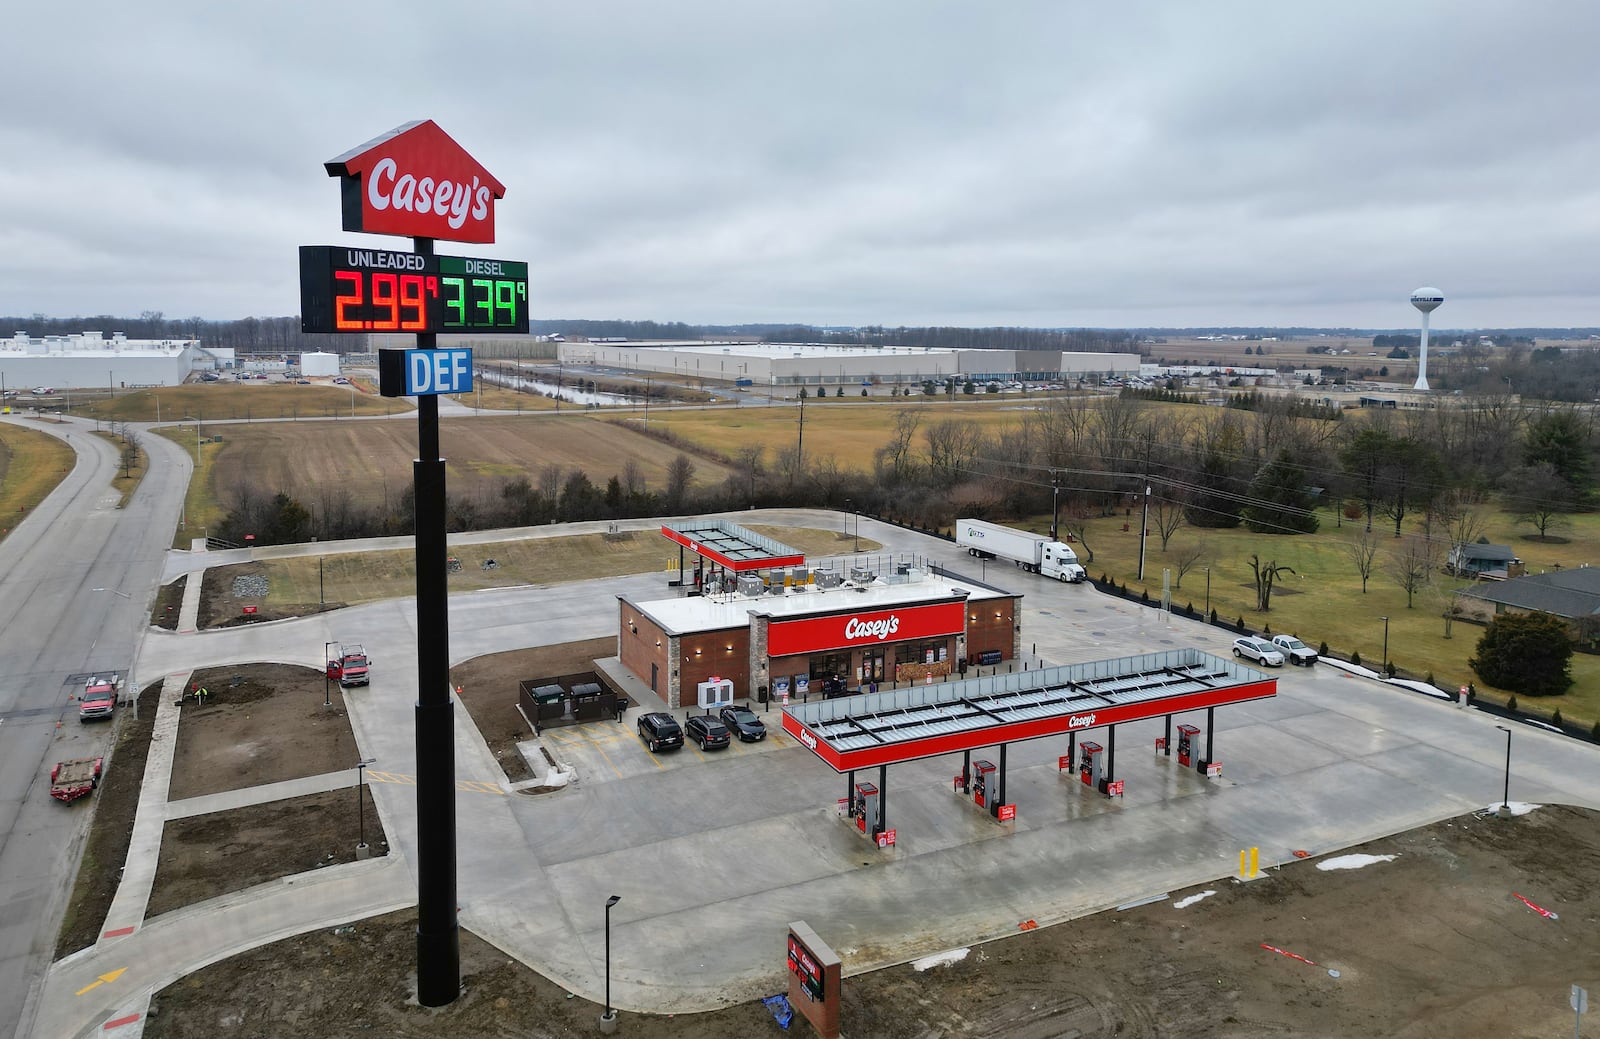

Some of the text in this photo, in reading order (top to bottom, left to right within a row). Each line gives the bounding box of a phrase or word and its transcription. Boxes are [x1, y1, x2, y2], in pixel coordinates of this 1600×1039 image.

[368, 157, 490, 230] Casey's
[348, 250, 425, 271] UNLEADED
[465, 260, 505, 276] DIESEL
[410, 352, 468, 393] DEF
[845, 614, 900, 640] Casey's
[1069, 713, 1096, 728] Casey's
[800, 728, 817, 750] Casey's
